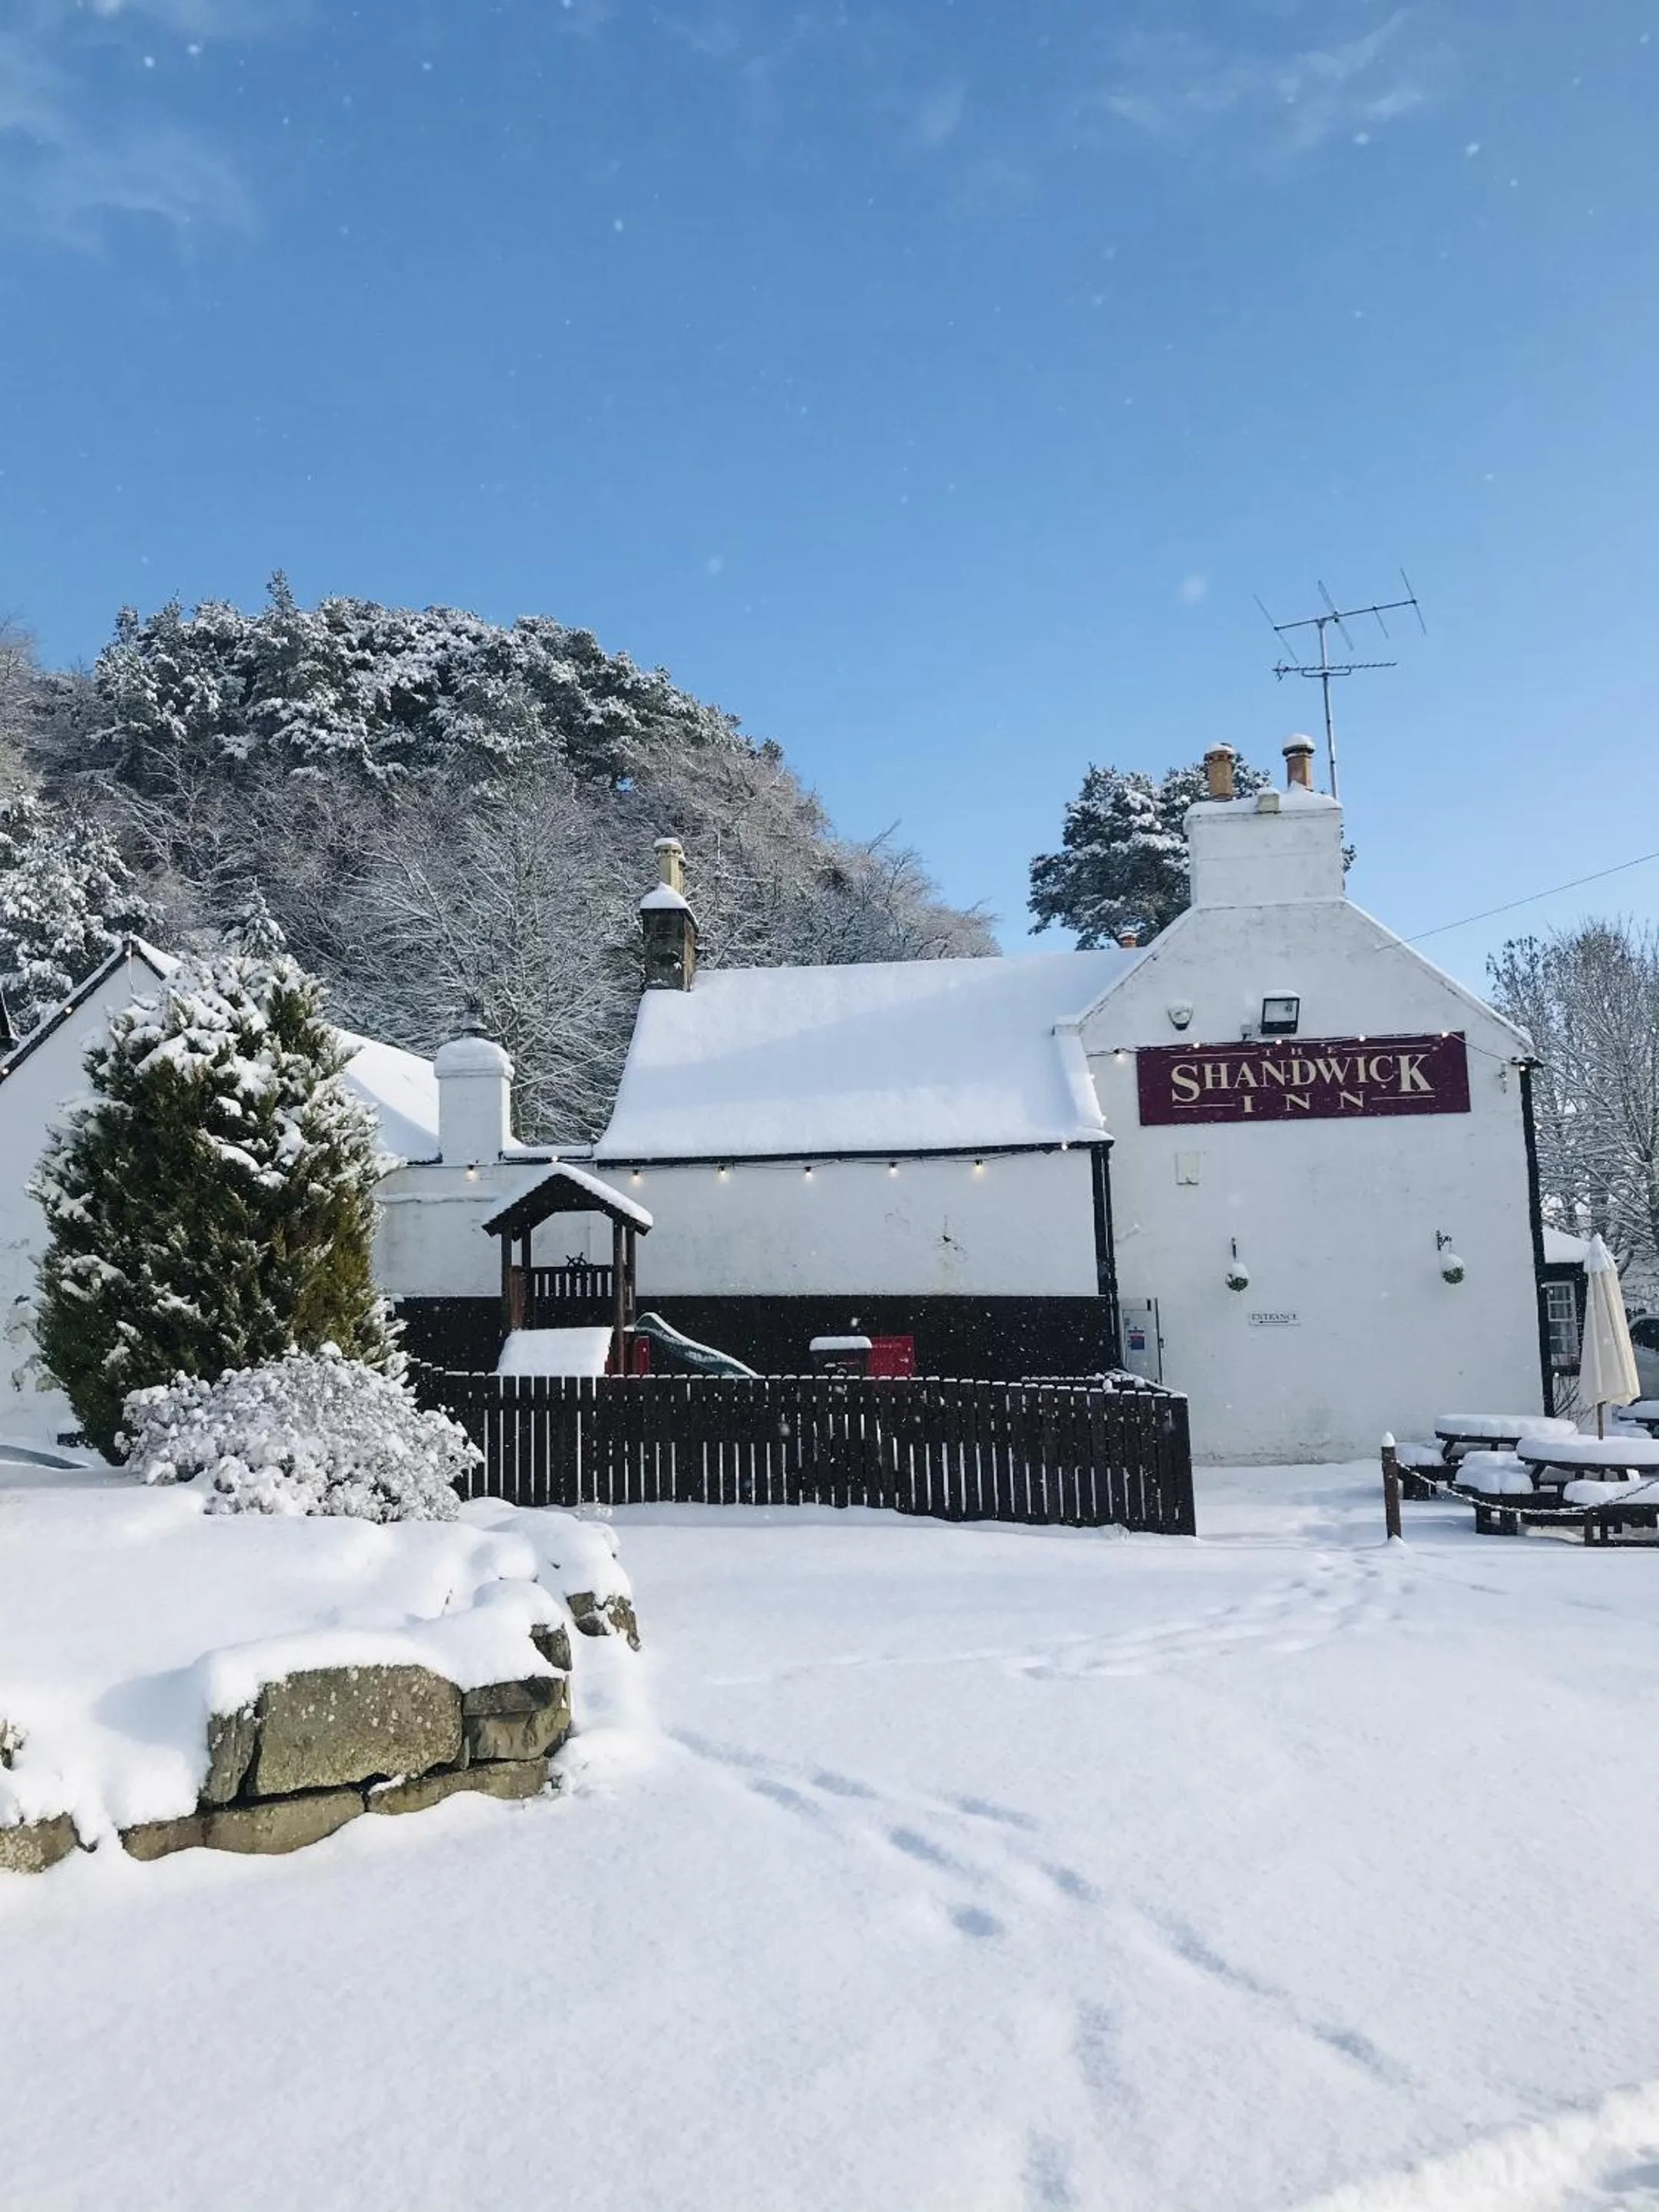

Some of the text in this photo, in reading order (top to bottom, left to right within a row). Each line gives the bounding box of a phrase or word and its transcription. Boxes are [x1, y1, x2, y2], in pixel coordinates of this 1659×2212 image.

[1264, 1045, 1338, 1057] THE
[1171, 1053, 1434, 1103] SHANDWICK
[1242, 1091, 1365, 1113] INN
